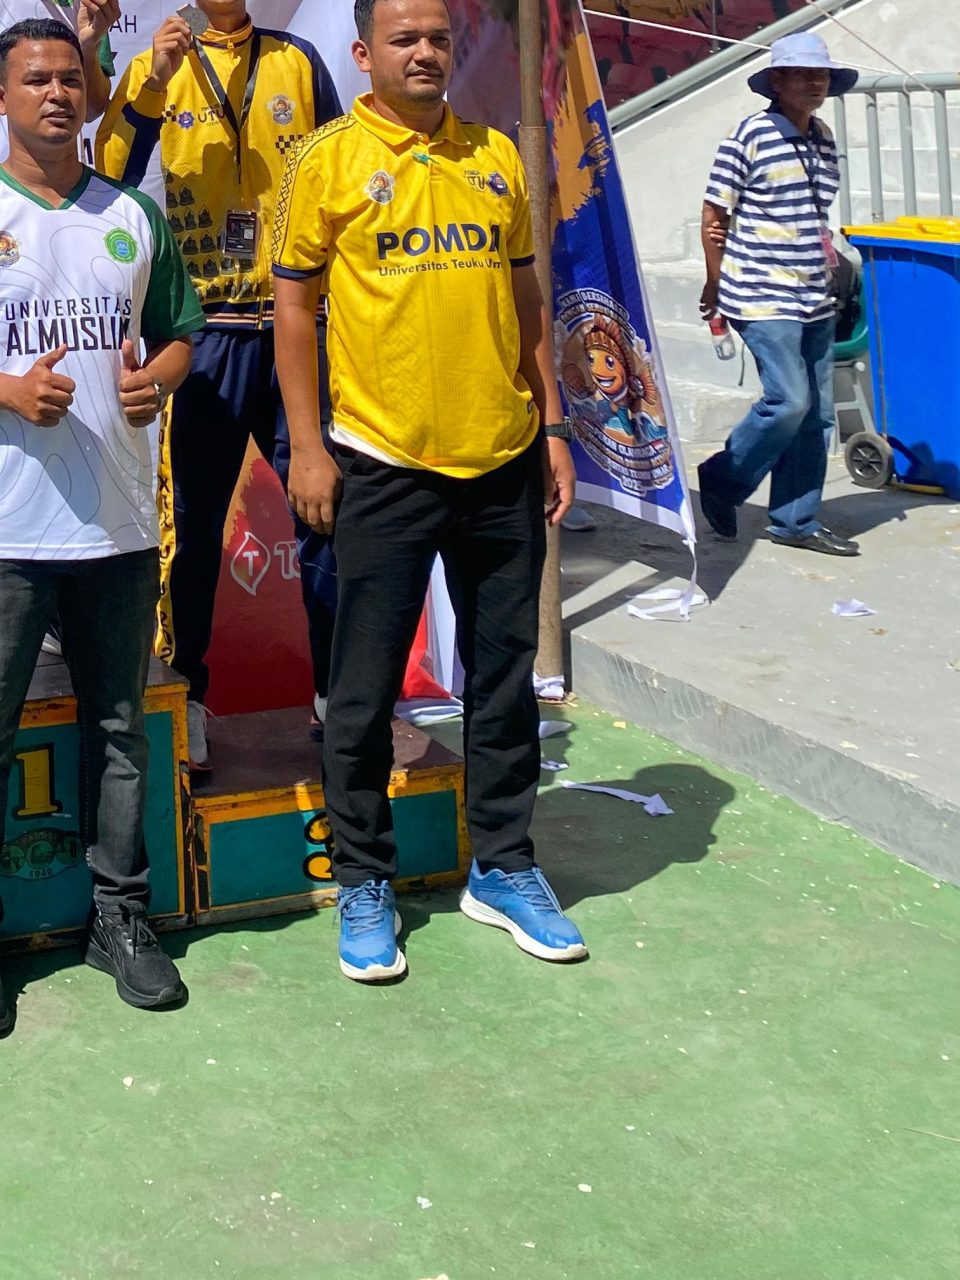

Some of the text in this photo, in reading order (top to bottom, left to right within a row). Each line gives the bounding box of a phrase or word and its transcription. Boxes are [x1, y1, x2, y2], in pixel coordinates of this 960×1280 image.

[376, 223, 500, 260] POMDA
[378, 262, 449, 277] Universitas
[451, 258, 484, 269] Teuku
[5, 296, 132, 321] UNIVERSITAS
[15, 748, 58, 816] 1
